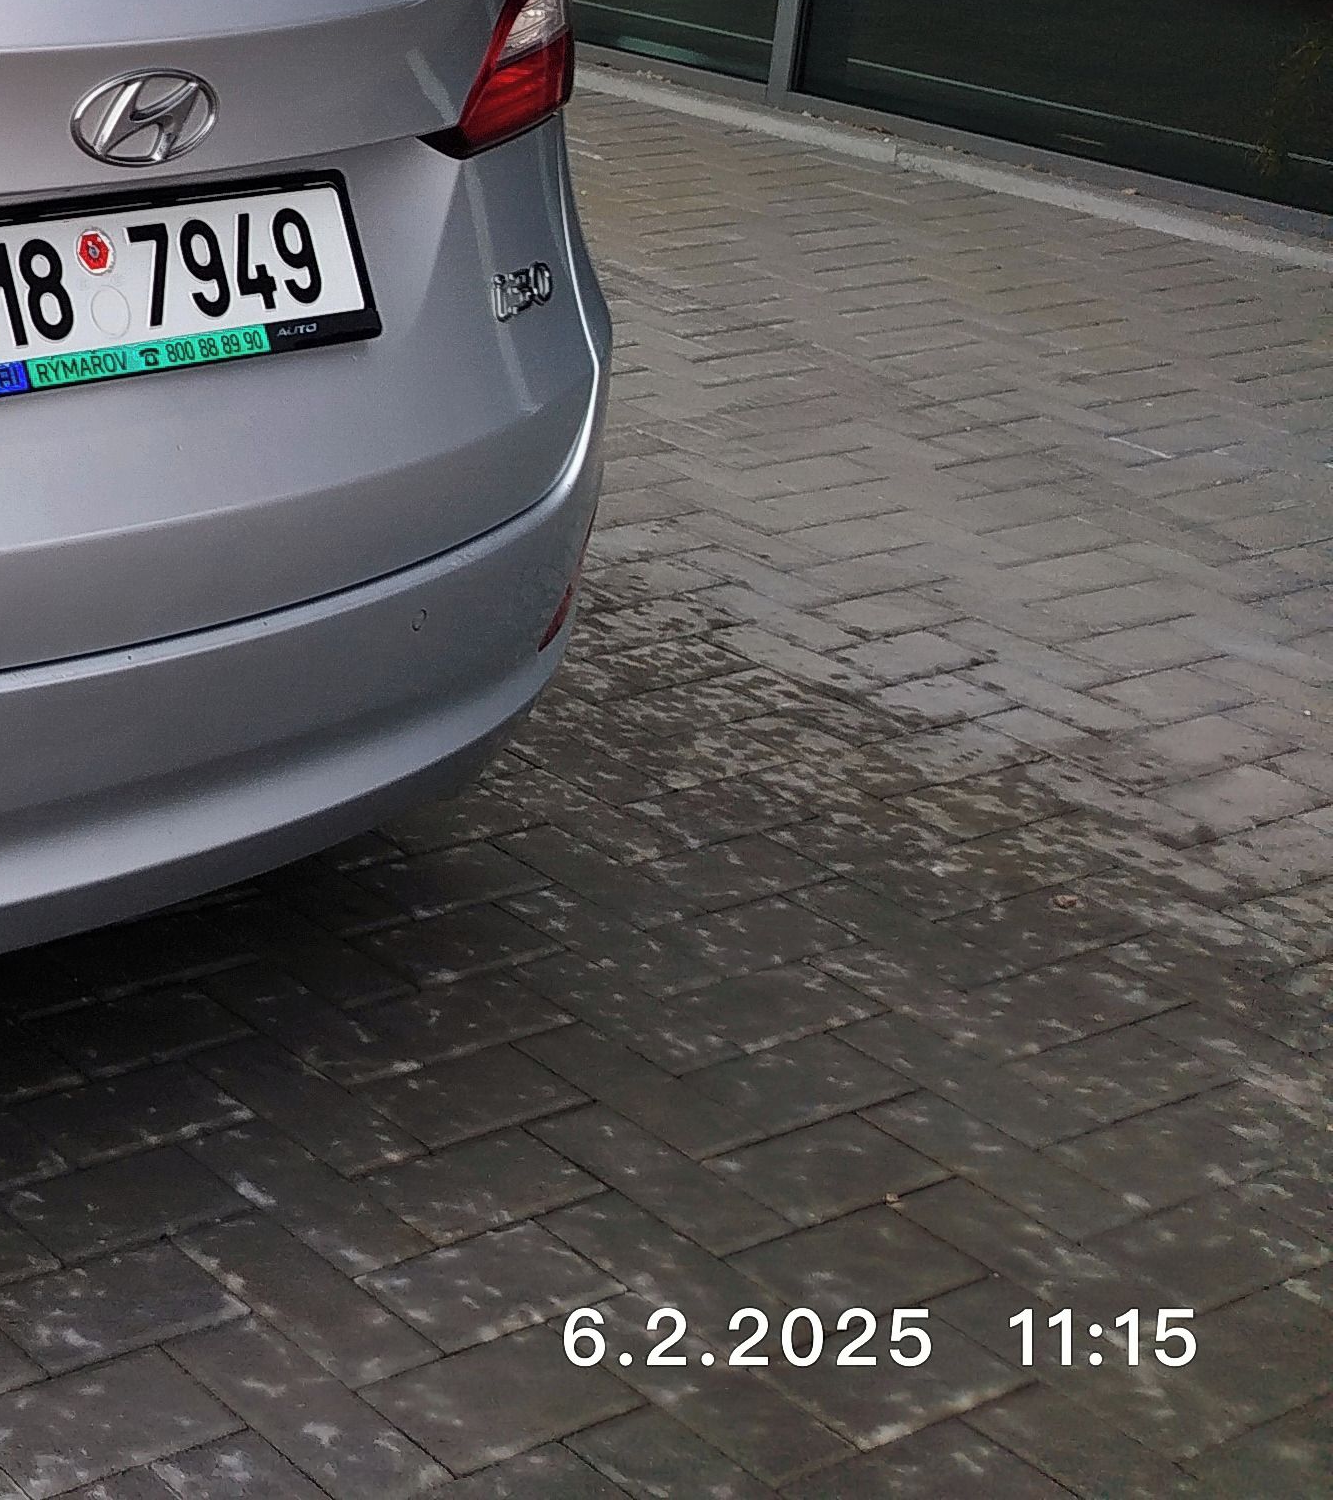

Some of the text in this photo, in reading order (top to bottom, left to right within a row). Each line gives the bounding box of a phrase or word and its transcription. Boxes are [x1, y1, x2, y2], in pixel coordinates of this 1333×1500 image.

[126, 208, 322, 326] 7949
[165, 341, 195, 362] 800
[198, 338, 219, 358] 88
[221, 334, 241, 354] 89
[243, 330, 263, 350] 90
[277, 323, 318, 337] AUTO
